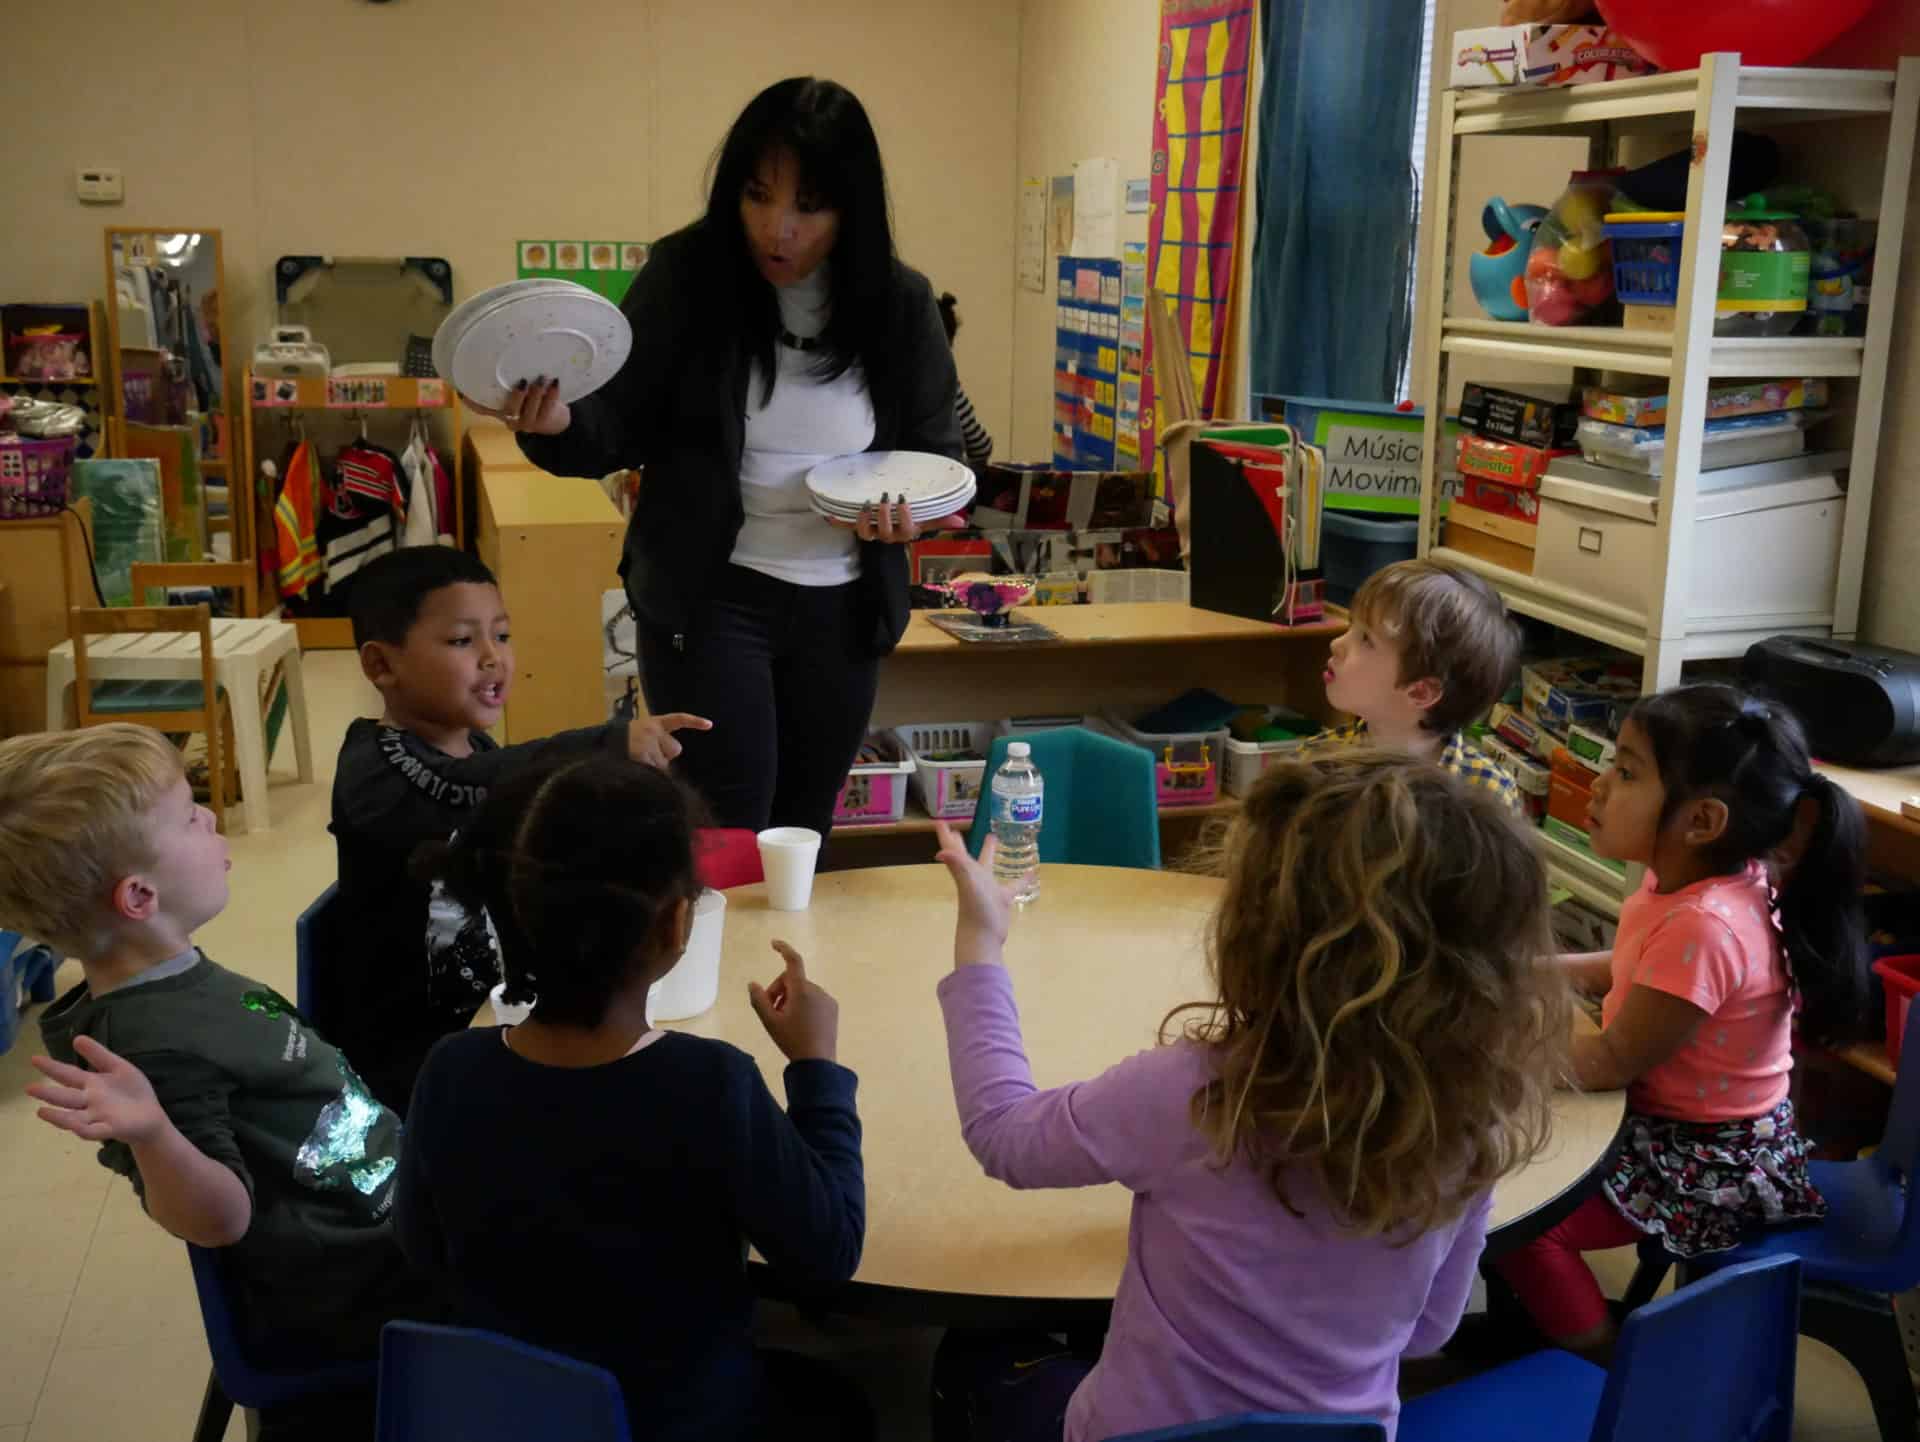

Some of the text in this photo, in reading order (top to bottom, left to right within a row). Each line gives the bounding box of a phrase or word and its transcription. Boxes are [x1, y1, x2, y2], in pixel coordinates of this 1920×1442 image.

[1152, 151, 1165, 173] 8
[1143, 408, 1153, 429] 3
[1343, 434, 1423, 463] Músic
